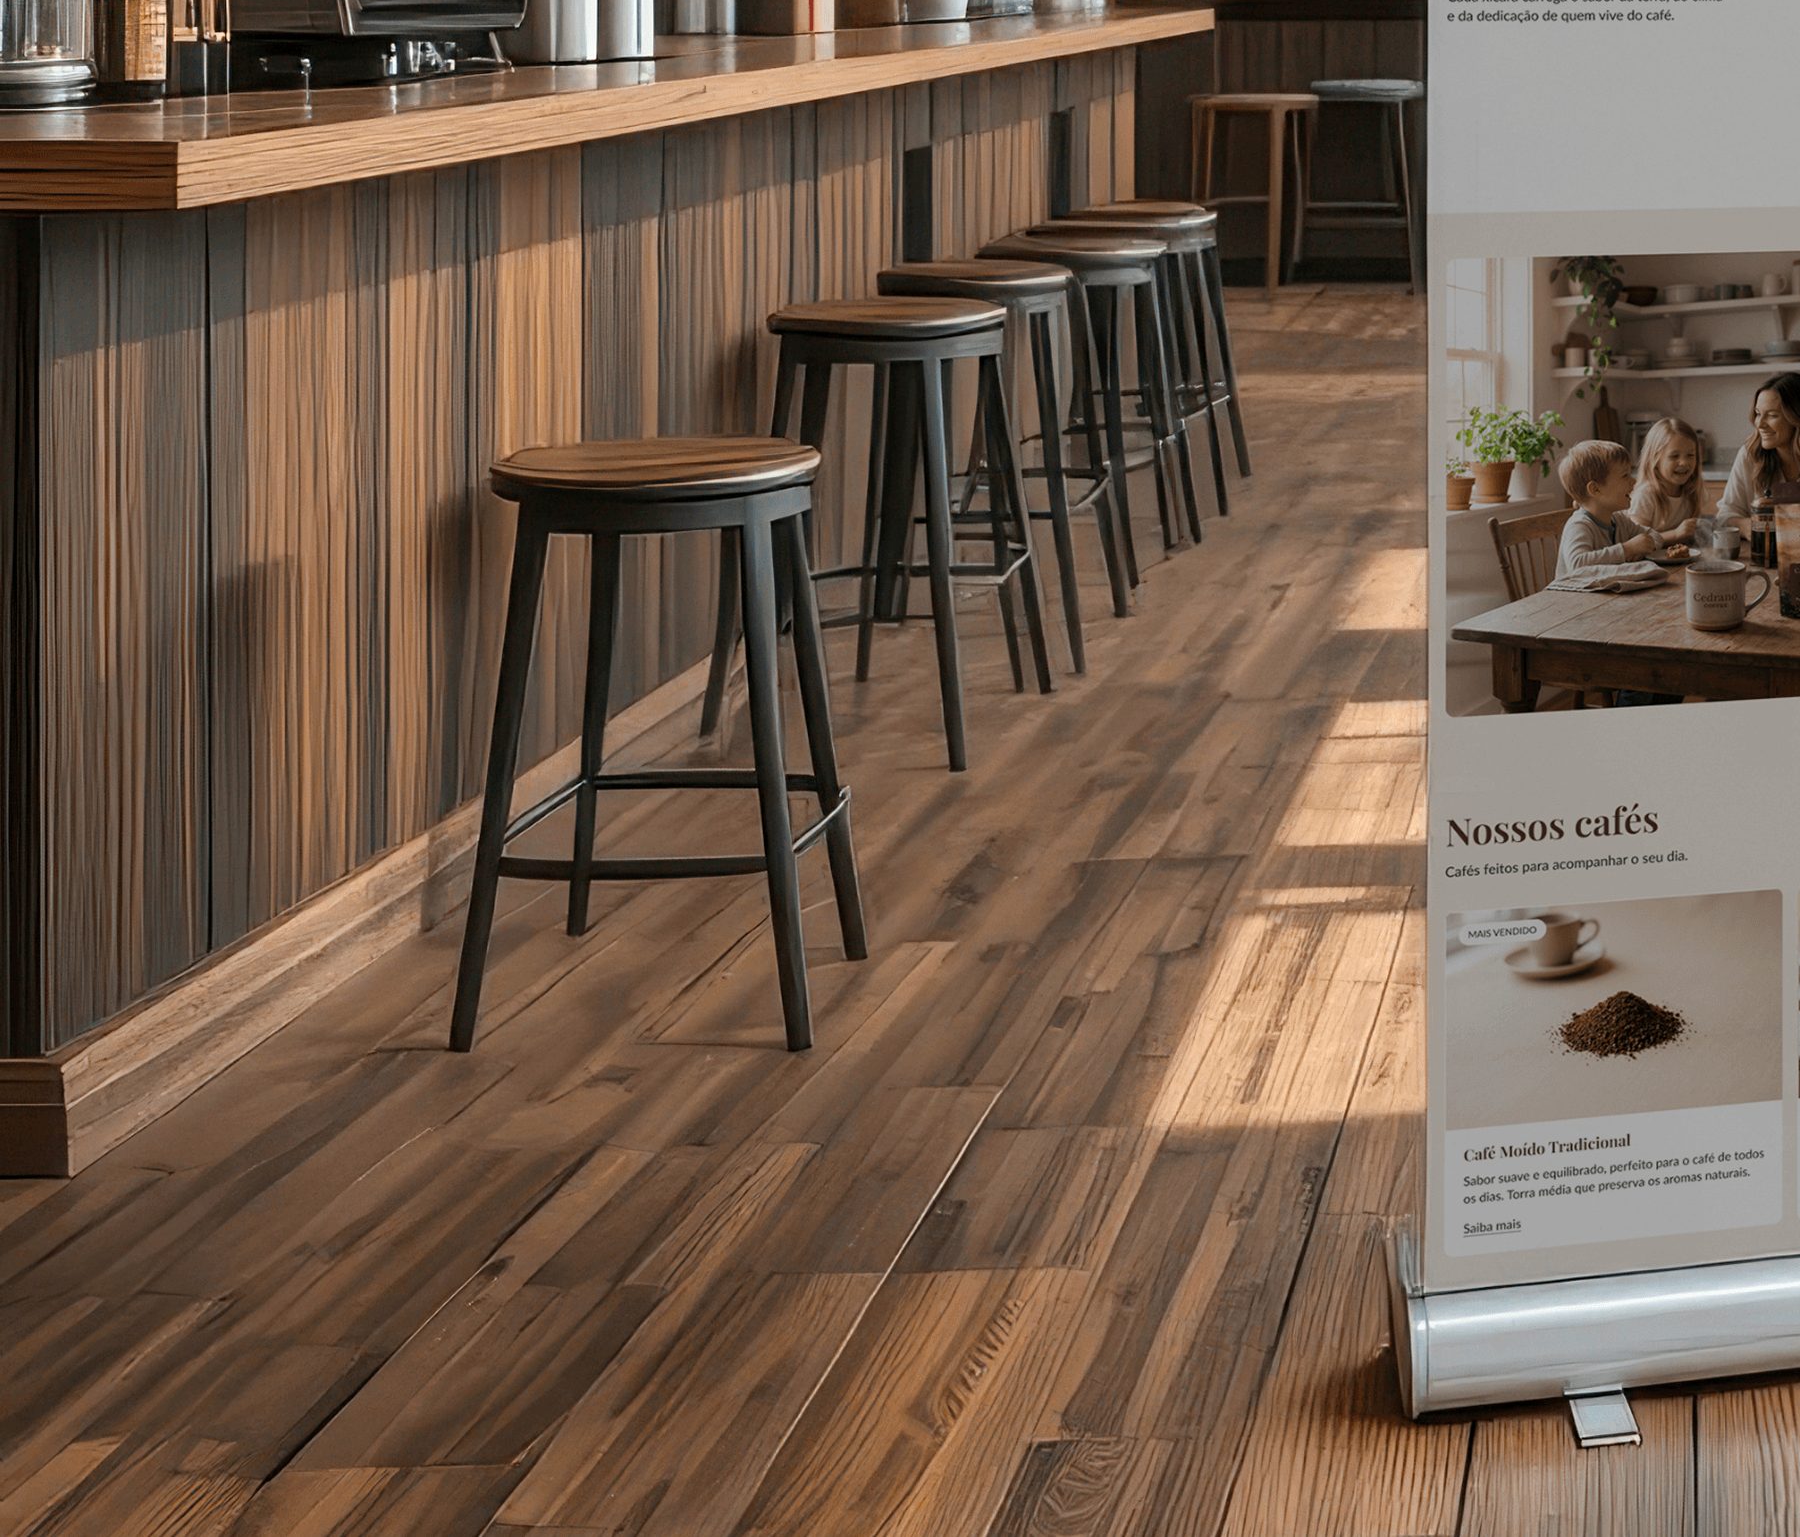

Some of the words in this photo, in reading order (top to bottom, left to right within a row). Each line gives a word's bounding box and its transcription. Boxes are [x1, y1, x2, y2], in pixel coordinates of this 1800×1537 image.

[1693, 592, 1738, 602] Cedrano
[1447, 818, 1564, 847] Nossos
[1575, 802, 1658, 838] cafés
[1444, 864, 1480, 878] Cafés
[1483, 862, 1519, 875] feitos
[1522, 862, 1549, 875] para
[1552, 854, 1628, 871] acompanhar
[1630, 855, 1639, 865] o
[1642, 854, 1663, 864] seu
[1666, 850, 1688, 862] dia.
[1468, 929, 1492, 939] MAIS
[1493, 925, 1537, 937] VENDIDO
[1463, 1145, 1496, 1161] Café
[1500, 1142, 1545, 1158] Moído
[1548, 1133, 1630, 1153] Tradicional
[1463, 1222, 1493, 1234] Saiba
[1496, 1218, 1521, 1231] mais
